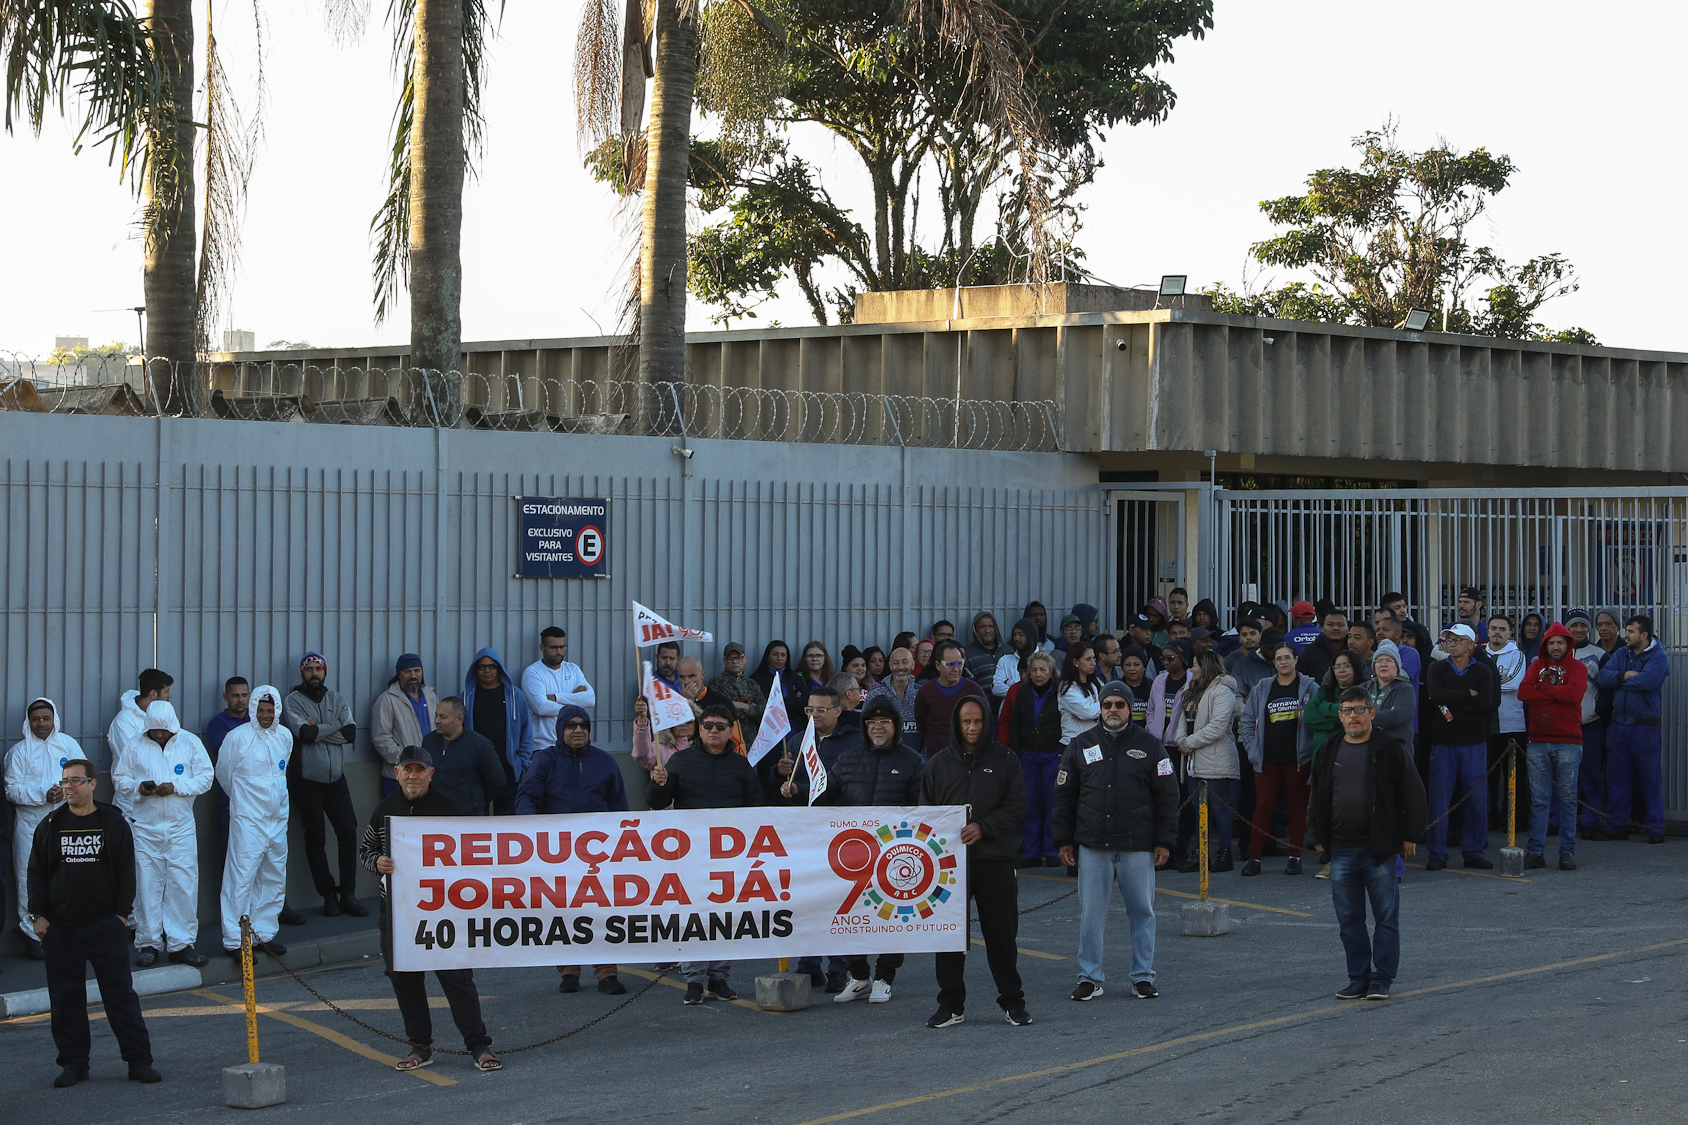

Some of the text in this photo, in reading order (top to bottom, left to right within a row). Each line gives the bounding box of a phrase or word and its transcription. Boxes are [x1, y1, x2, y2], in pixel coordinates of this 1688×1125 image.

[523, 504, 604, 516] ESTACIONAMENTO
[527, 528, 573, 538] EXCLUSIVO
[538, 541, 562, 549] PARA
[583, 535, 596, 556] E
[526, 552, 573, 562] VISITANTES
[1267, 700, 1299, 709] Carnaval
[830, 821, 858, 829] RUMO
[61, 835, 102, 846] BLACK
[61, 845, 102, 856] FRIDAY
[422, 819, 789, 874] REDUÇÃO DA
[886, 845, 925, 860] QUÍMICOS
[417, 860, 791, 911] JORNADA JÁ!
[831, 915, 871, 926] ANOS
[415, 909, 794, 951] 40 HORAS SEMANAIS
[829, 925, 904, 934] CONSTRUINDO
[916, 923, 957, 932] FUTURO
